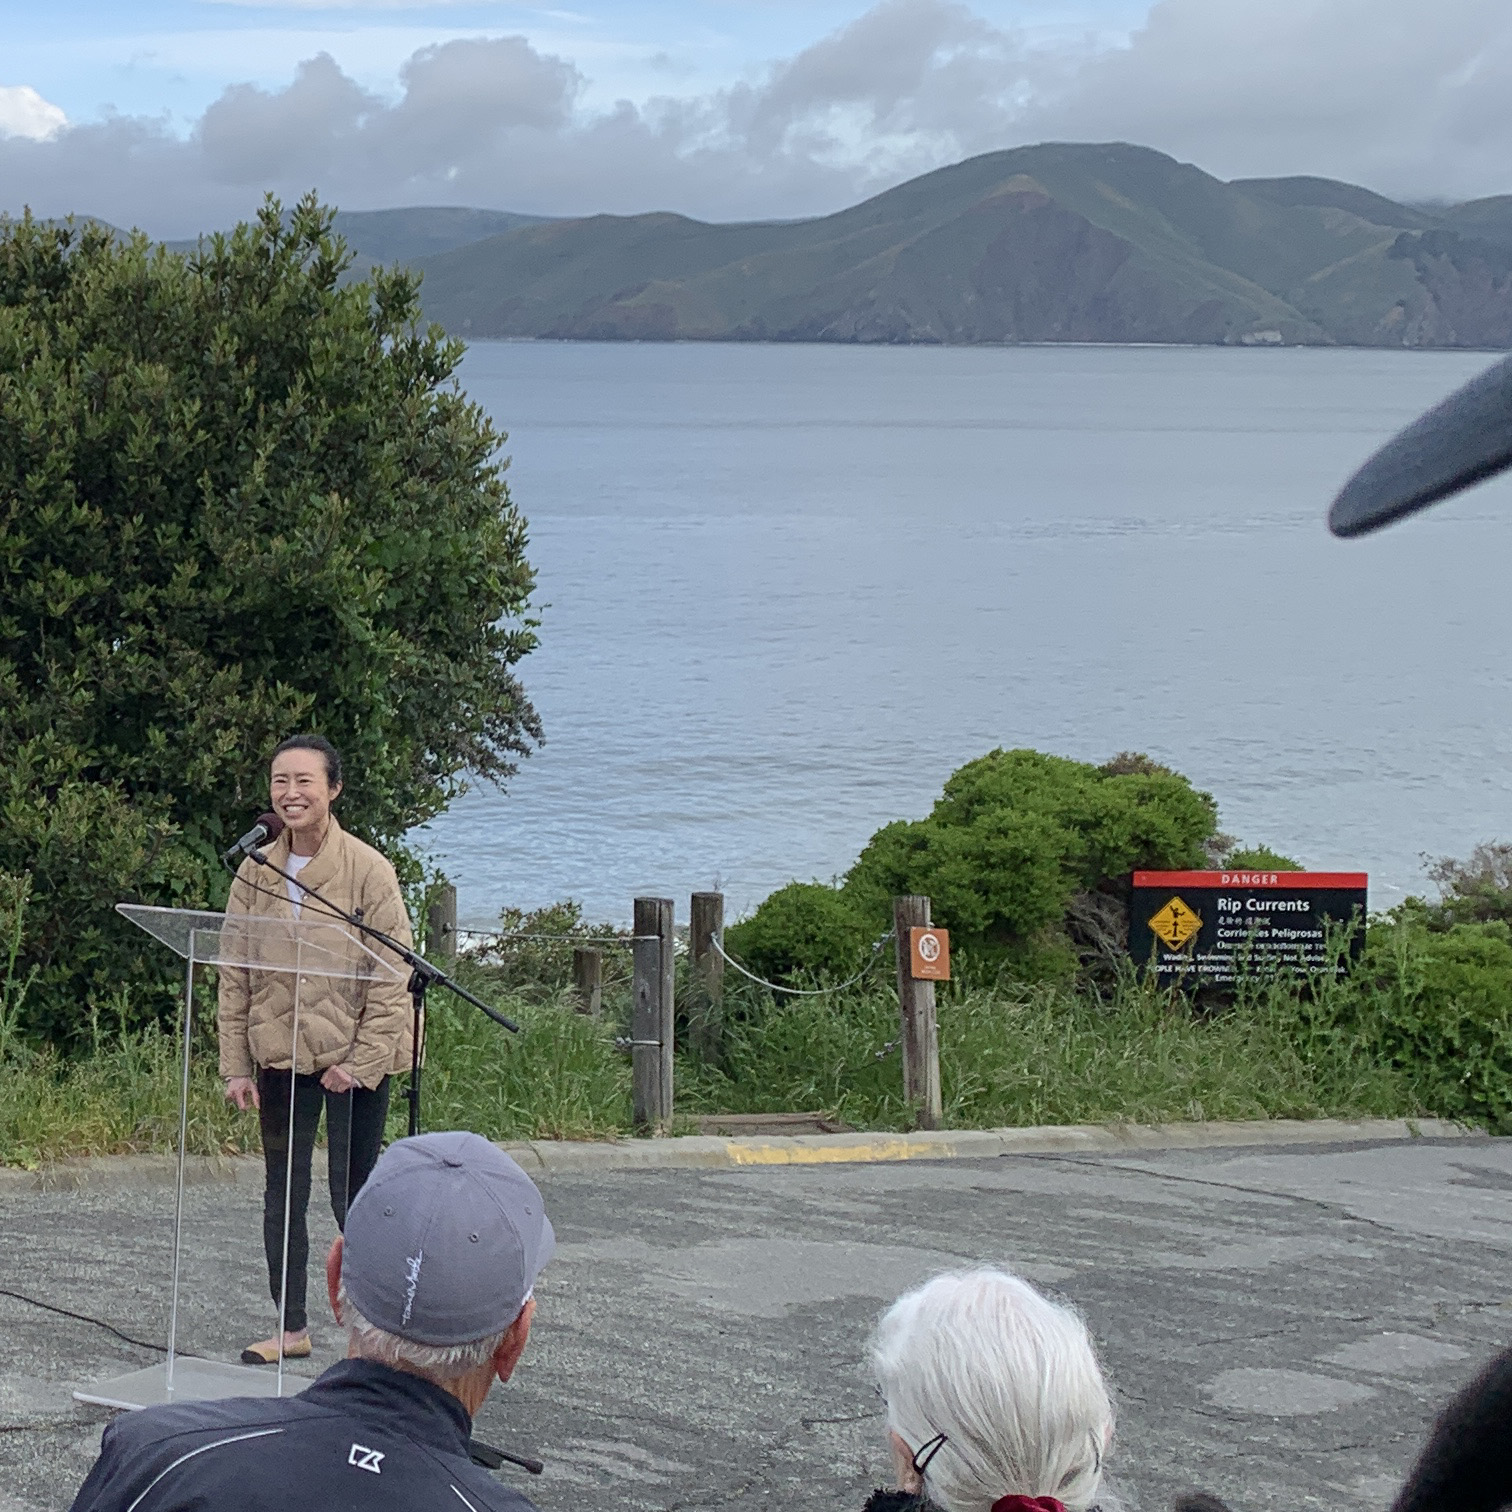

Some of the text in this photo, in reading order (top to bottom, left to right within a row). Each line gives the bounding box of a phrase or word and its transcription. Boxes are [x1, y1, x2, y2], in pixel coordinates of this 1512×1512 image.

[1221, 874, 1278, 885] DANGER
[1217, 898, 1310, 914] Rip Currents
[1271, 928, 1323, 940] Peligrosas
